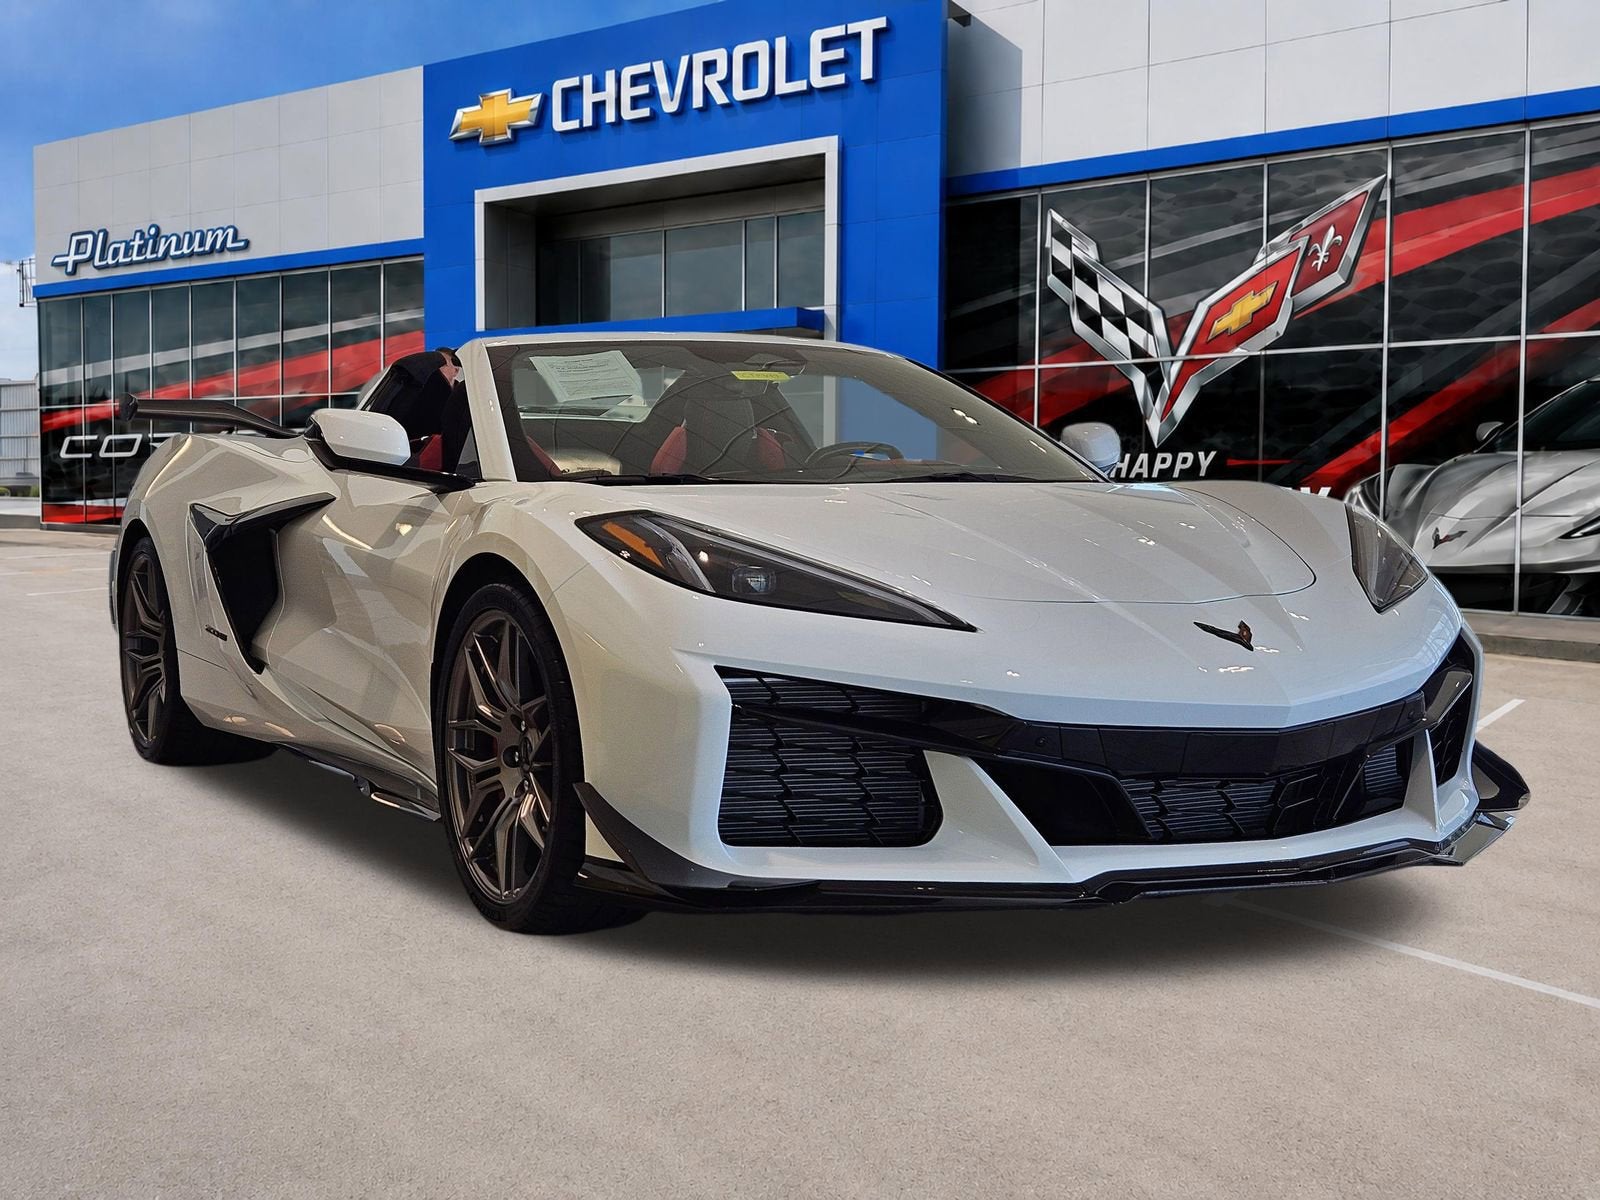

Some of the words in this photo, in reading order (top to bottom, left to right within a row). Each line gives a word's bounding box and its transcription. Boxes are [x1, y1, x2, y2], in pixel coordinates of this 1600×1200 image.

[551, 16, 888, 132] CHEVROLET
[51, 223, 250, 276] Platinum
[1110, 451, 1217, 478] HAPPY
